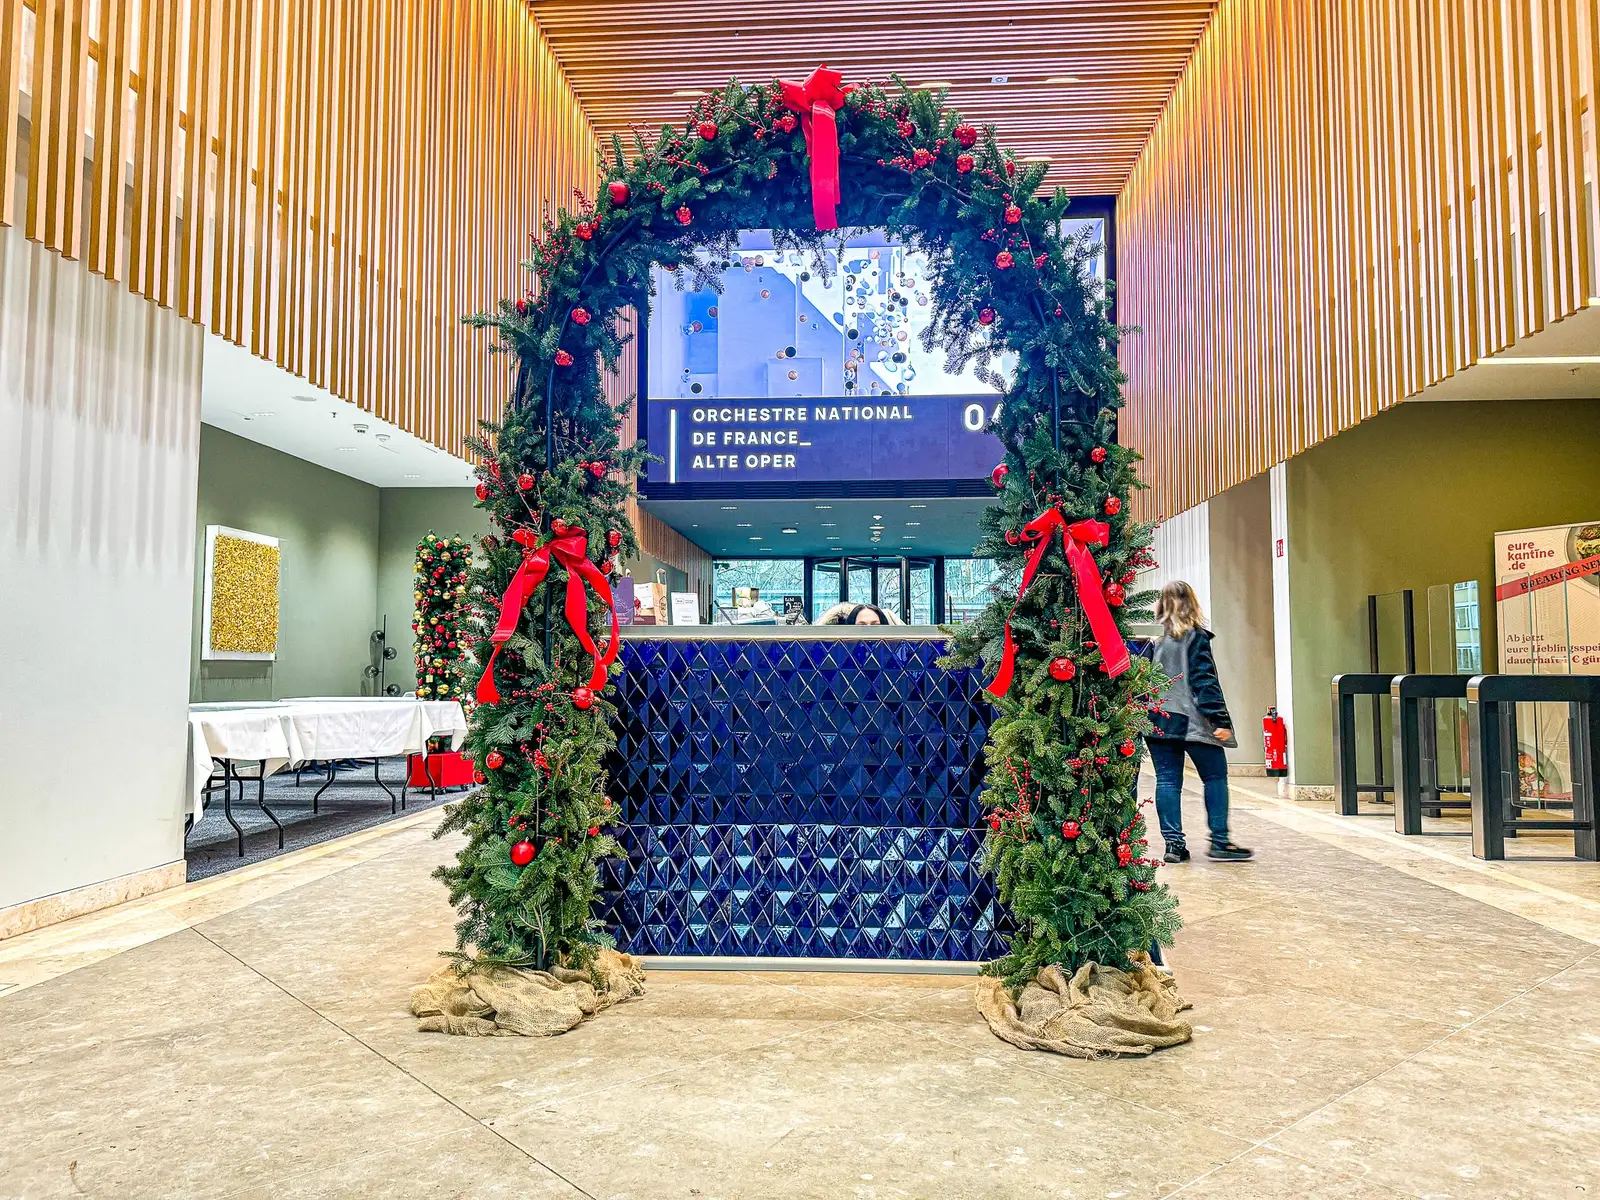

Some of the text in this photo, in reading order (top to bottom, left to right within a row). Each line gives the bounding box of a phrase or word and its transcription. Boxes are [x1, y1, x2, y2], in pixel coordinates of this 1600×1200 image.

[692, 405, 913, 422] ORCHESTRE NATIONAL
[692, 431, 716, 445] DE
[691, 453, 796, 469] ALTE OPER
[1507, 541, 1535, 551] eure
[1520, 565, 1580, 590] BREAKING
[1506, 634, 1544, 643] Ab jetzt
